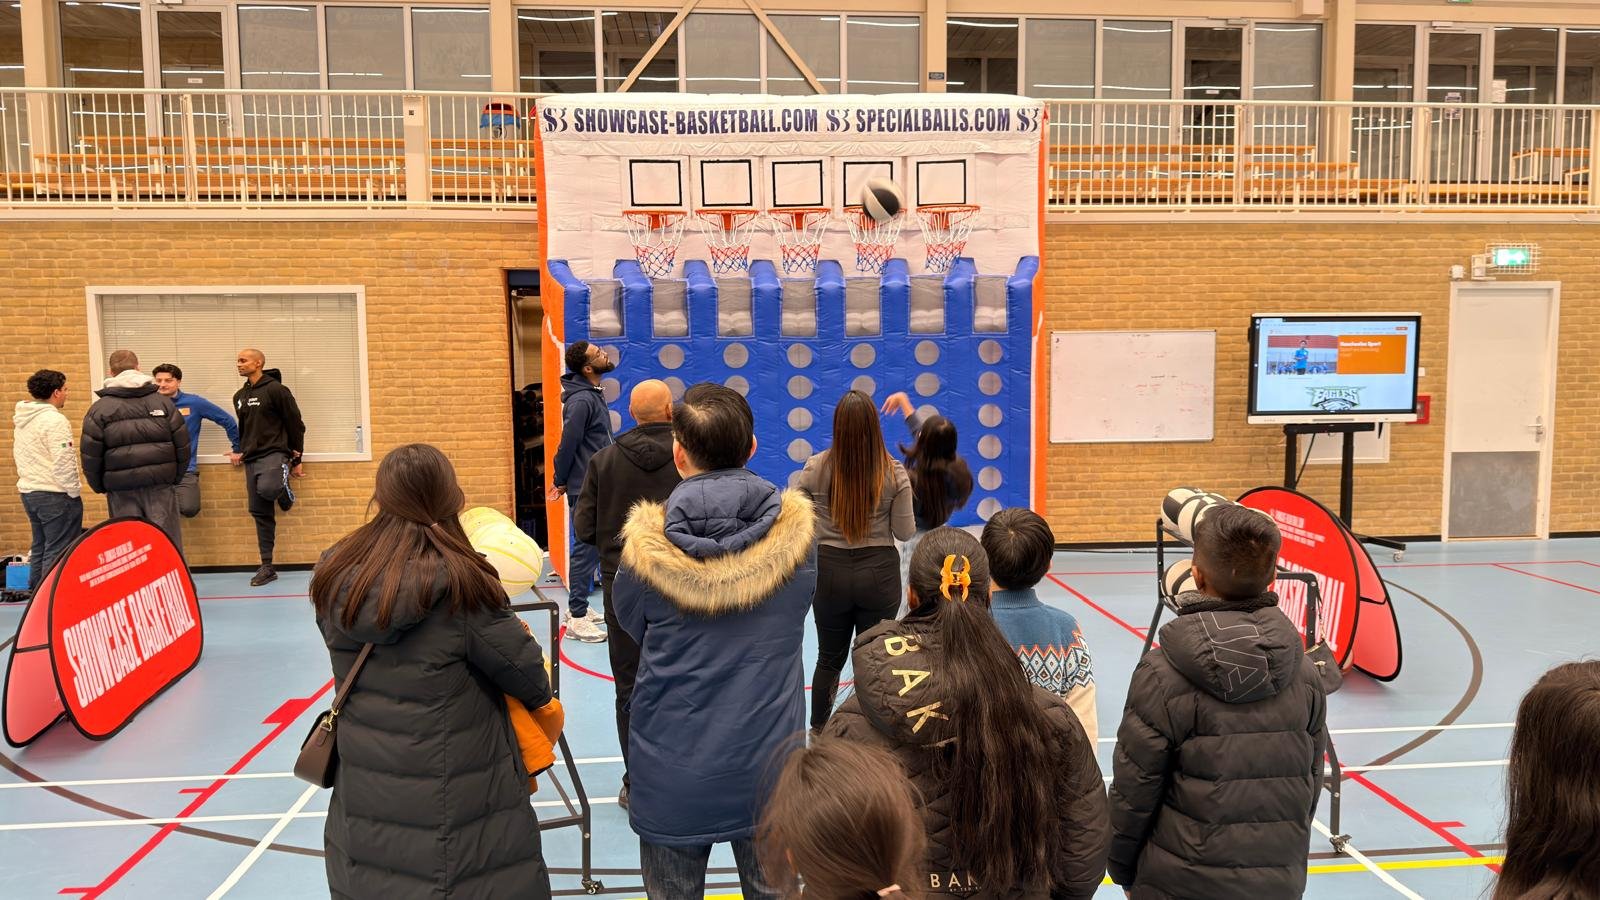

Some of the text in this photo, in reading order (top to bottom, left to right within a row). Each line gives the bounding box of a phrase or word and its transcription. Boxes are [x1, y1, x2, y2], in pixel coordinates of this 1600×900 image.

[574, 107, 818, 135] SHOWCASE-BASKETBALL.COM
[856, 107, 1010, 133] SPECIALBALLS.COM
[1317, 389, 1358, 402] EAGLES
[63, 568, 196, 708] SHOWCASE BASKETBALL
